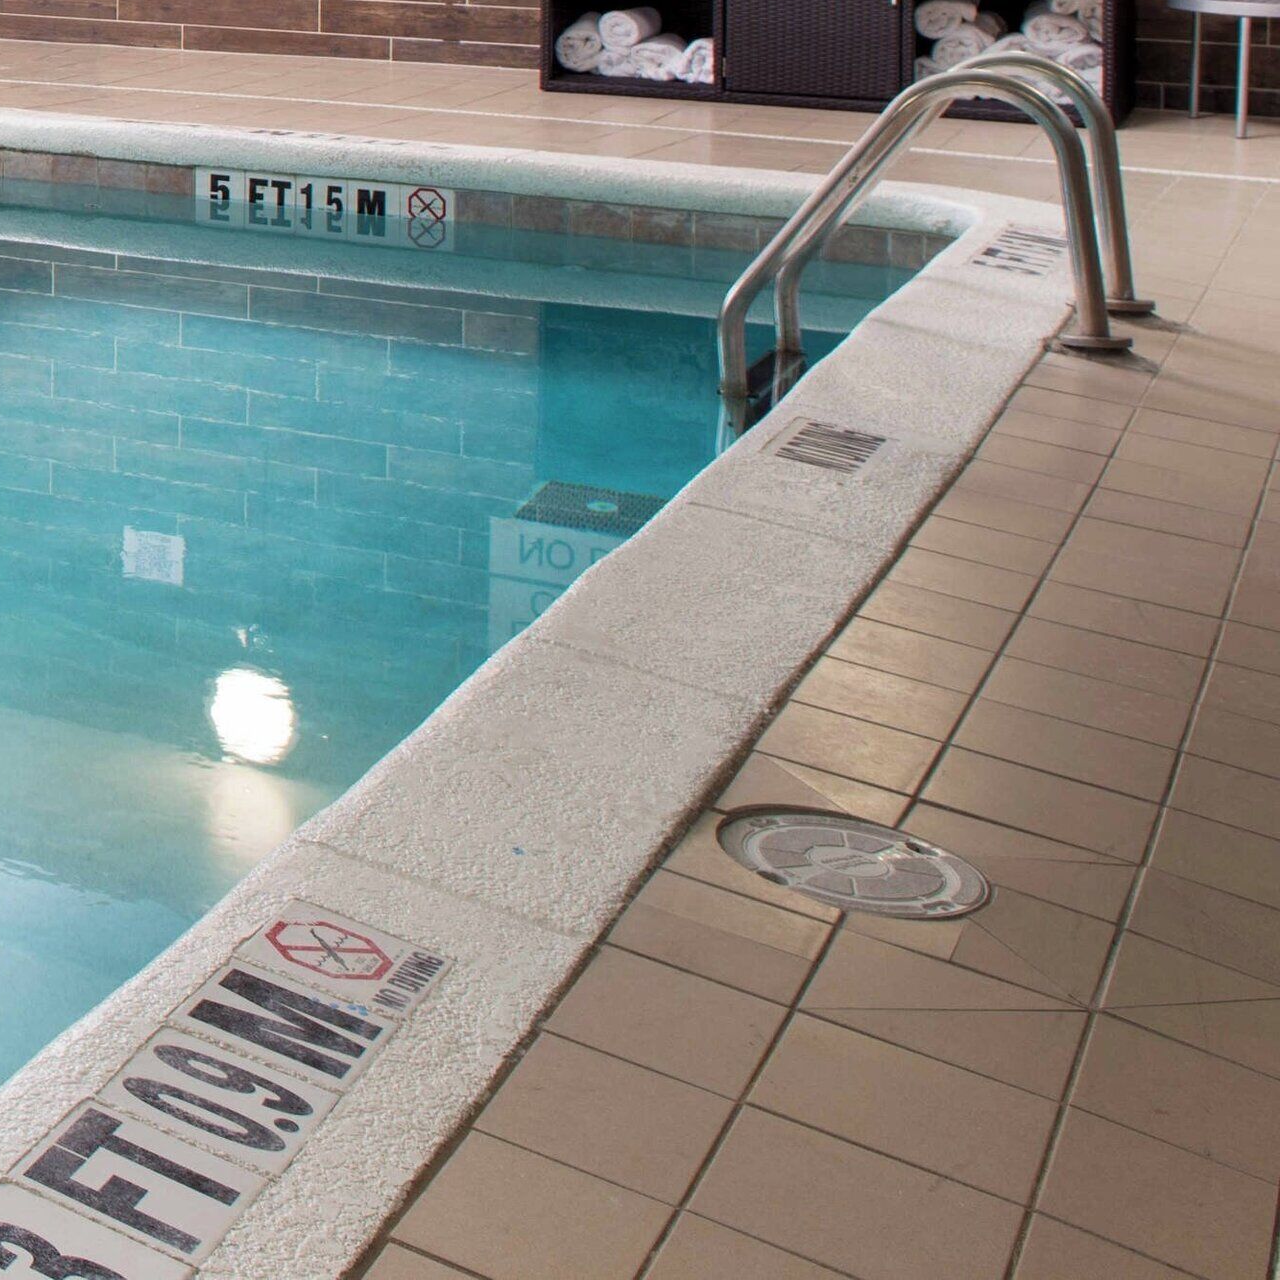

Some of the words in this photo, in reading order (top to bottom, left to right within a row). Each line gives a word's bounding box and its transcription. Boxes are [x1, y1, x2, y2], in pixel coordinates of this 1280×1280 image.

[210, 174, 230, 201] 5
[249, 178, 292, 206] FT
[357, 189, 386, 217] M
[372, 988, 411, 1012] NO
[386, 951, 444, 993] DIVING
[187, 968, 384, 1079] M
[122, 1045, 313, 1152] 0.9
[23, 1108, 240, 1254] FT
